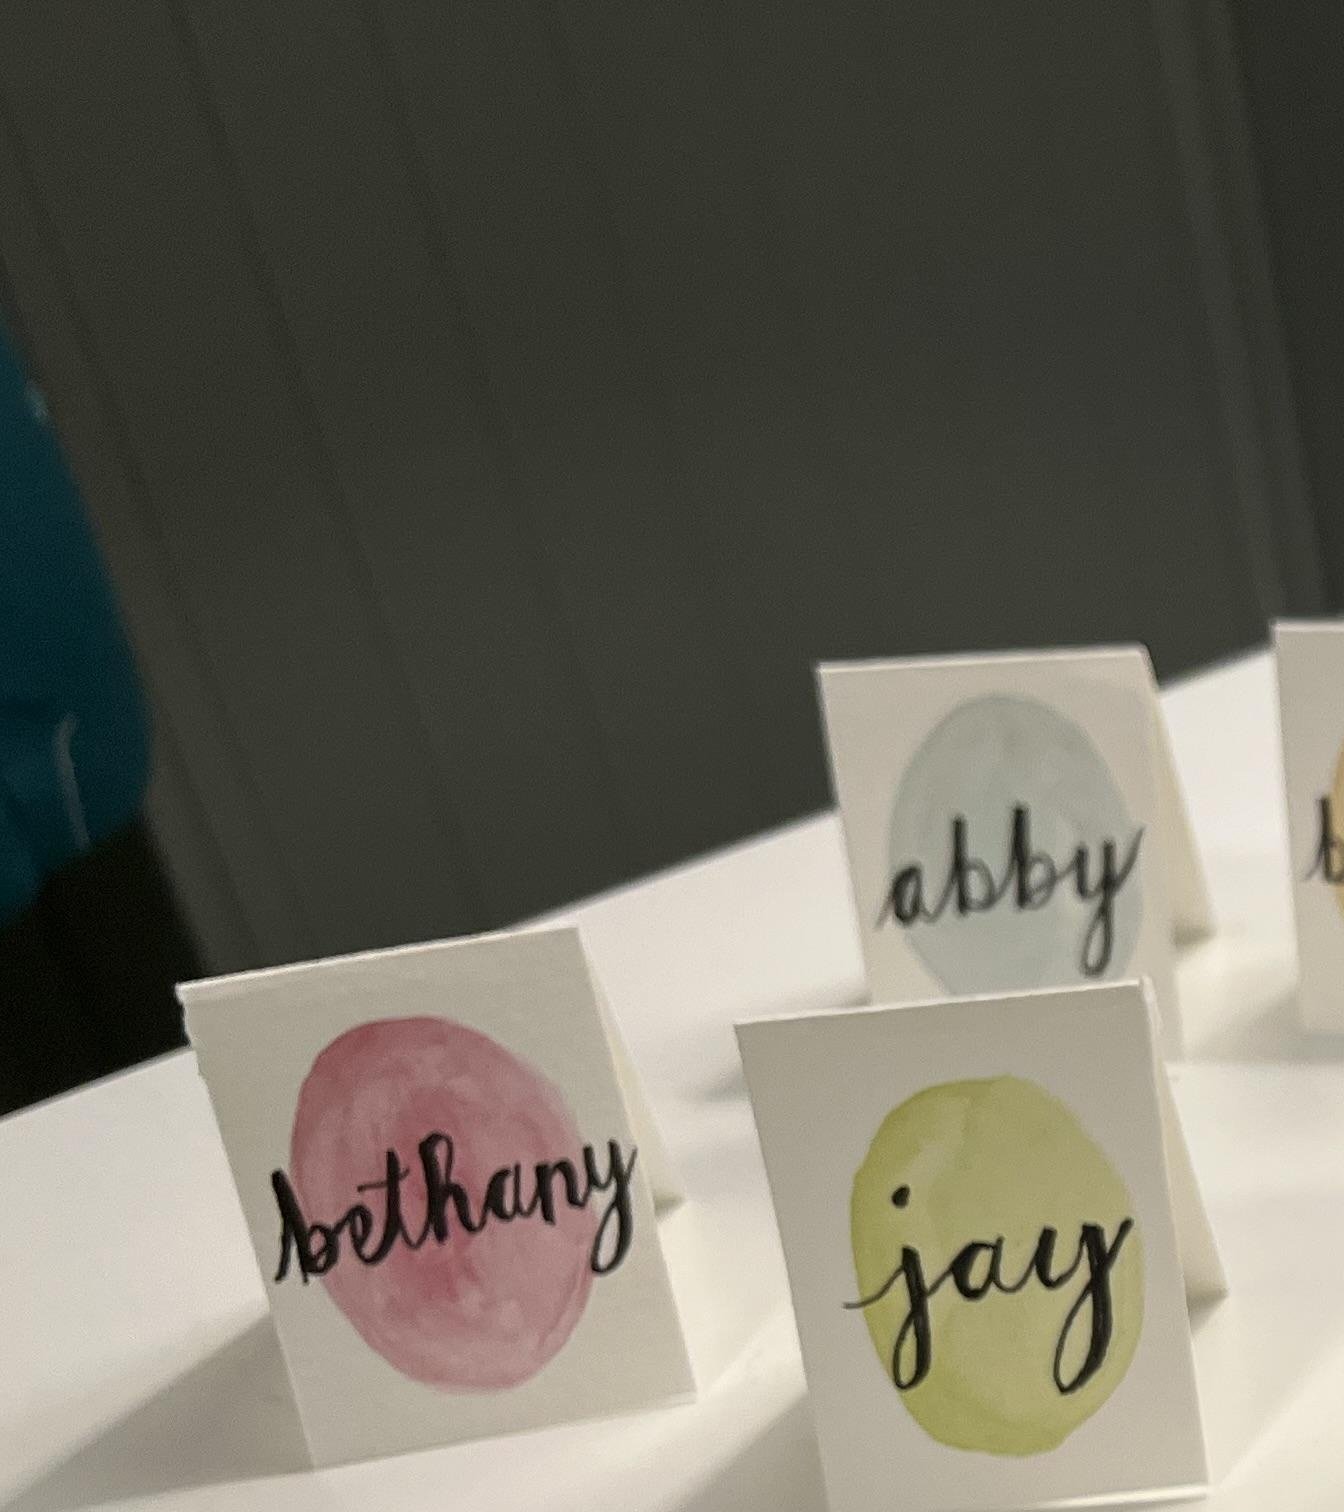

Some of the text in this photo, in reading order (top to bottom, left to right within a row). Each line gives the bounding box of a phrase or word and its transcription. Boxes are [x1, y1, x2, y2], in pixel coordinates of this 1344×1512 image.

[876, 804, 1144, 976] abby
[270, 1130, 636, 1285] bethany
[844, 1184, 1134, 1396] jay
